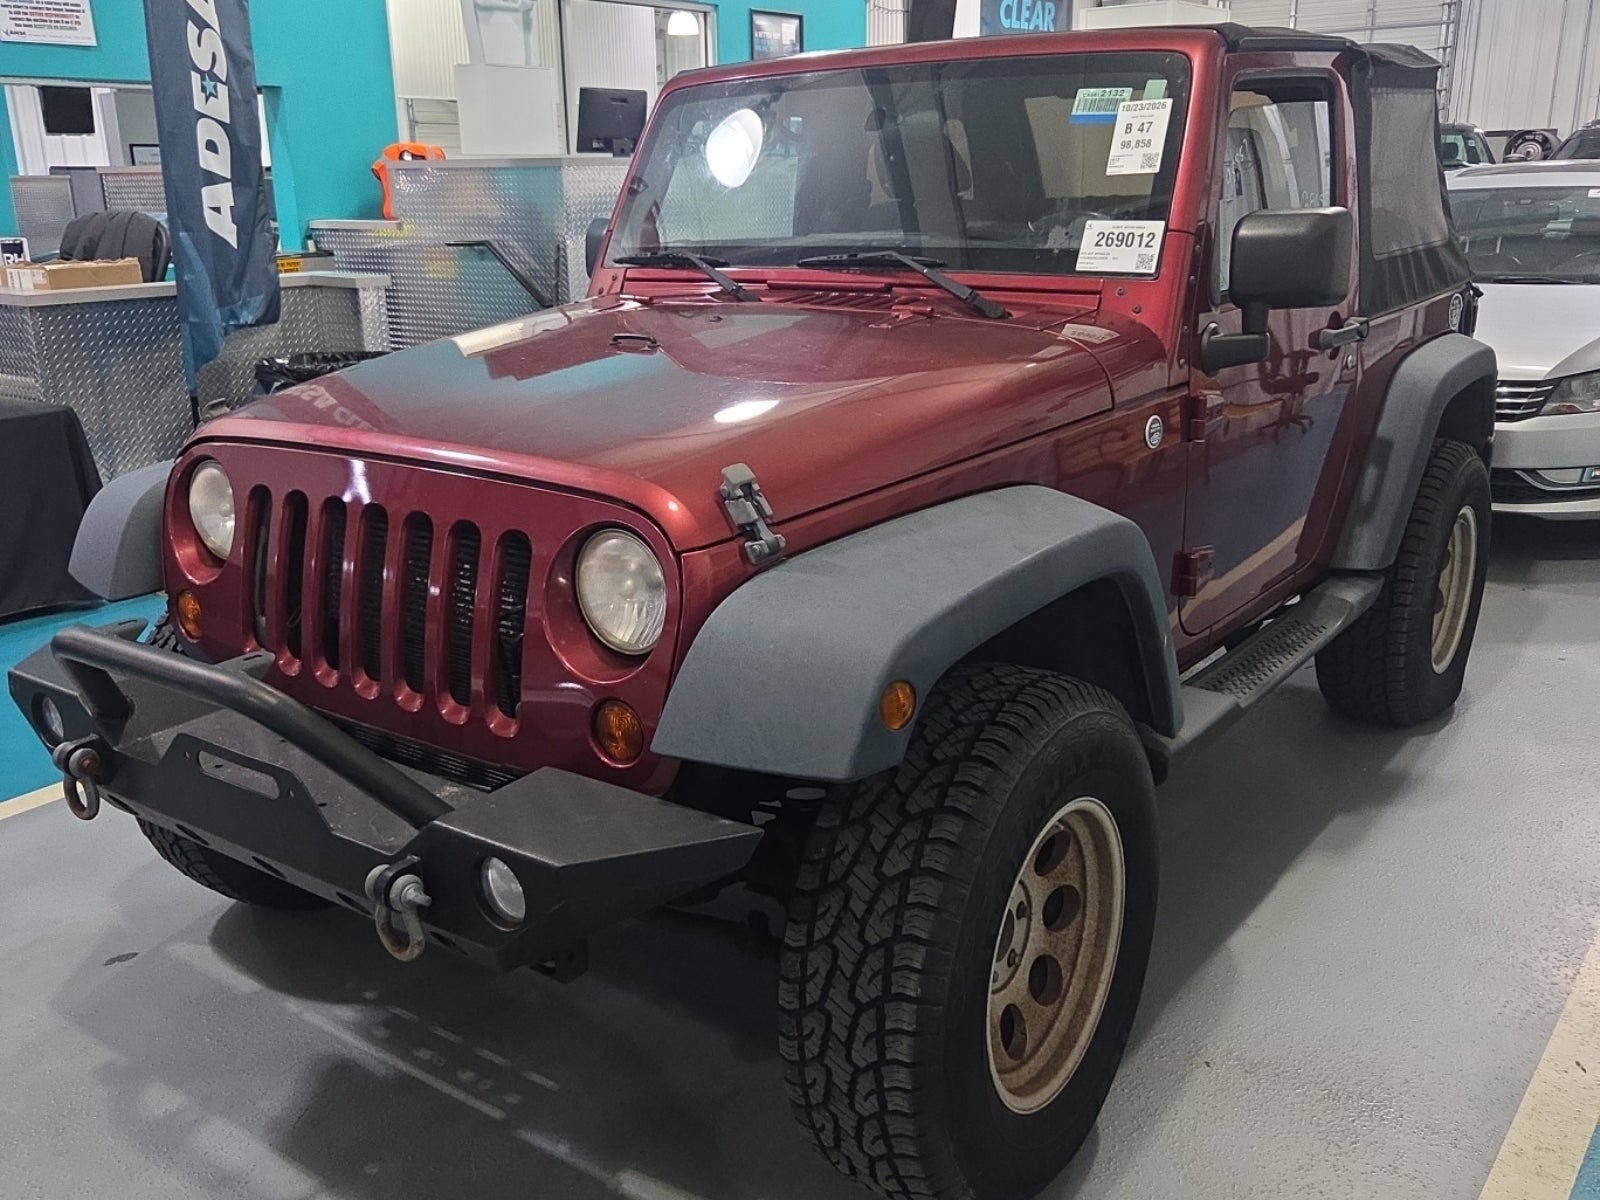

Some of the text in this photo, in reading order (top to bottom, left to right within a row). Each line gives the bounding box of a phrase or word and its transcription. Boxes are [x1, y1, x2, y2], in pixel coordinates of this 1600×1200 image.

[999, 0, 1055, 32] CLEAR
[1100, 89, 1125, 97] 2132
[1124, 121, 1153, 134] B 47
[1120, 138, 1152, 150] 98,858
[1094, 231, 1156, 248] 269012
